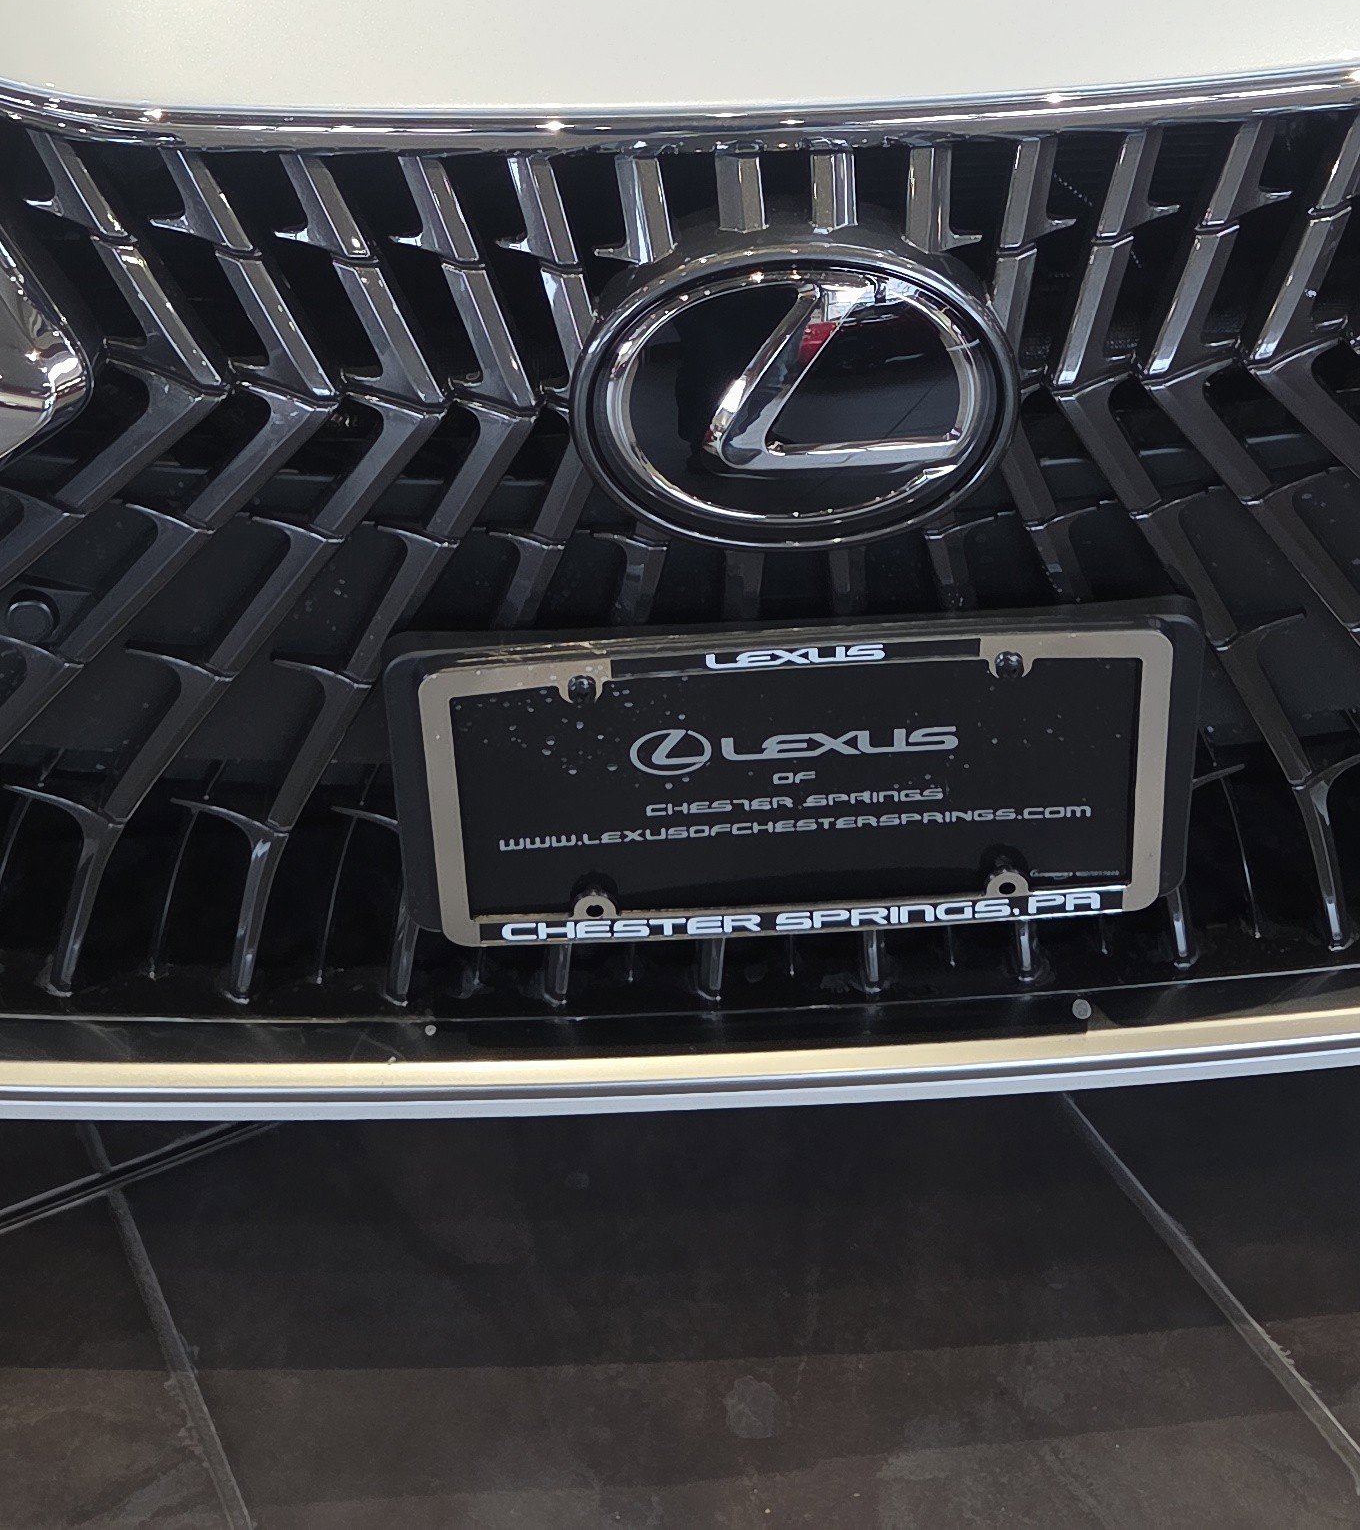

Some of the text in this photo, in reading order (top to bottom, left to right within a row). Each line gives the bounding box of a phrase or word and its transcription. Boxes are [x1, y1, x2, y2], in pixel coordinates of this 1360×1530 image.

[705, 643, 886, 670] LEXUS
[720, 725, 959, 760] LEXUS
[772, 770, 816, 785] OF
[646, 787, 943, 817] CHESTER SPRINGS
[501, 914, 762, 941] CHESTER
[1027, 892, 1101, 914] PA
